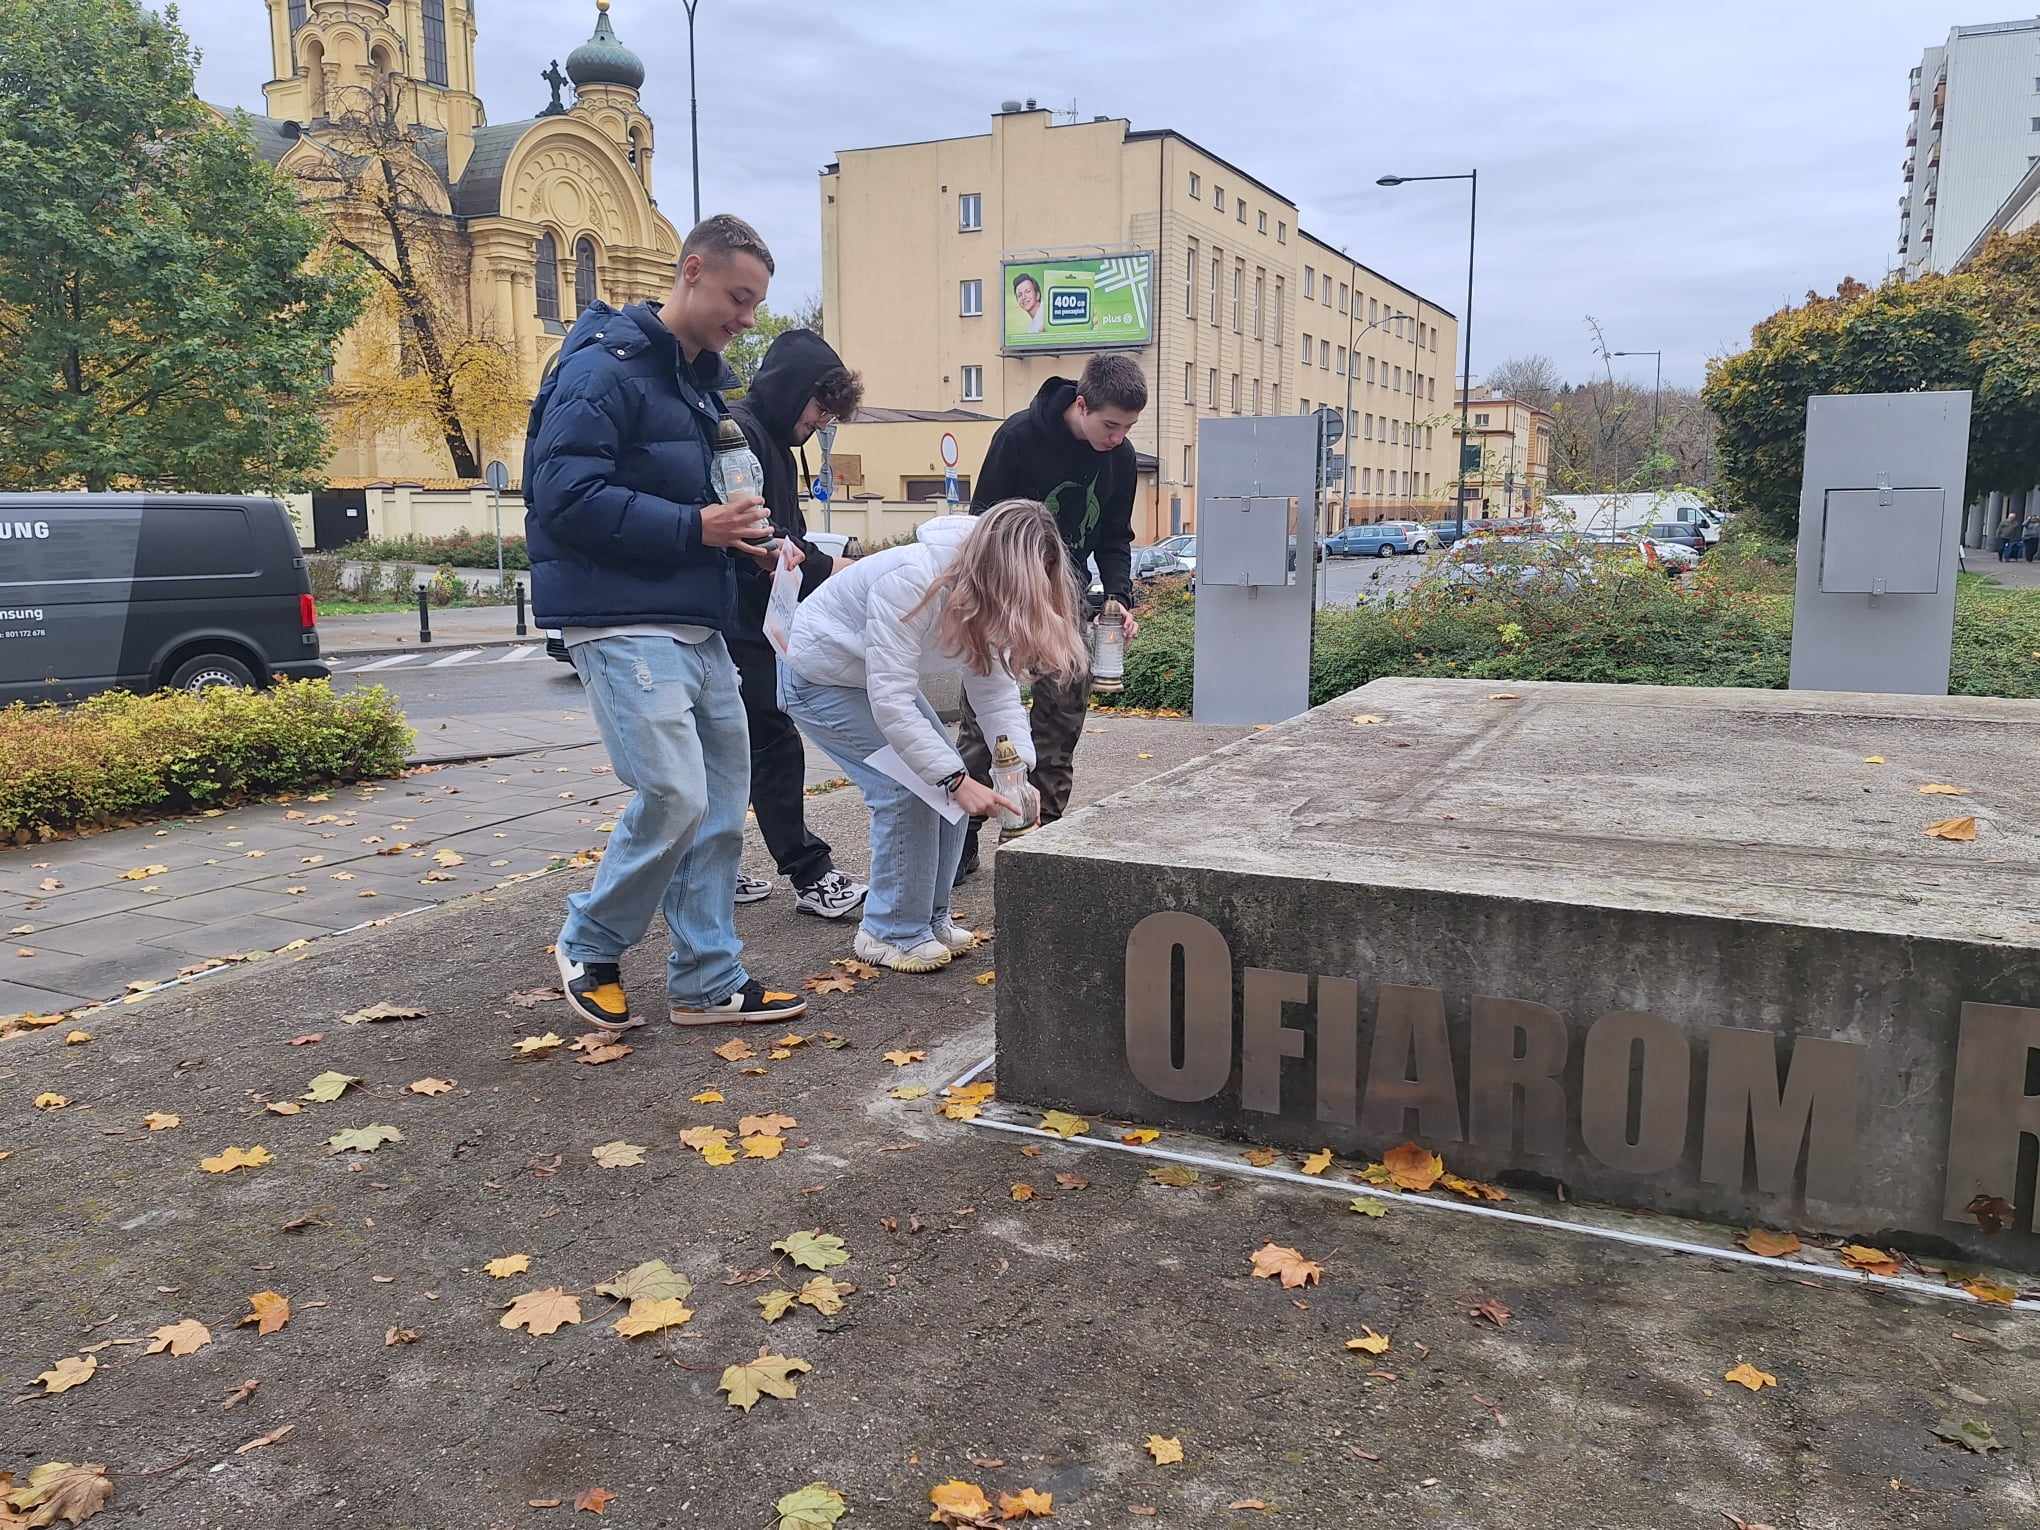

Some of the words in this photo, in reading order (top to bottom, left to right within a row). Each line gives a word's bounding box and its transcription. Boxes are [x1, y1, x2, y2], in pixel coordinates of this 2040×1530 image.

[1054, 296, 1077, 308] 400
[1103, 313, 1122, 325] plus
[1124, 911, 1868, 1205] OFIAROM
